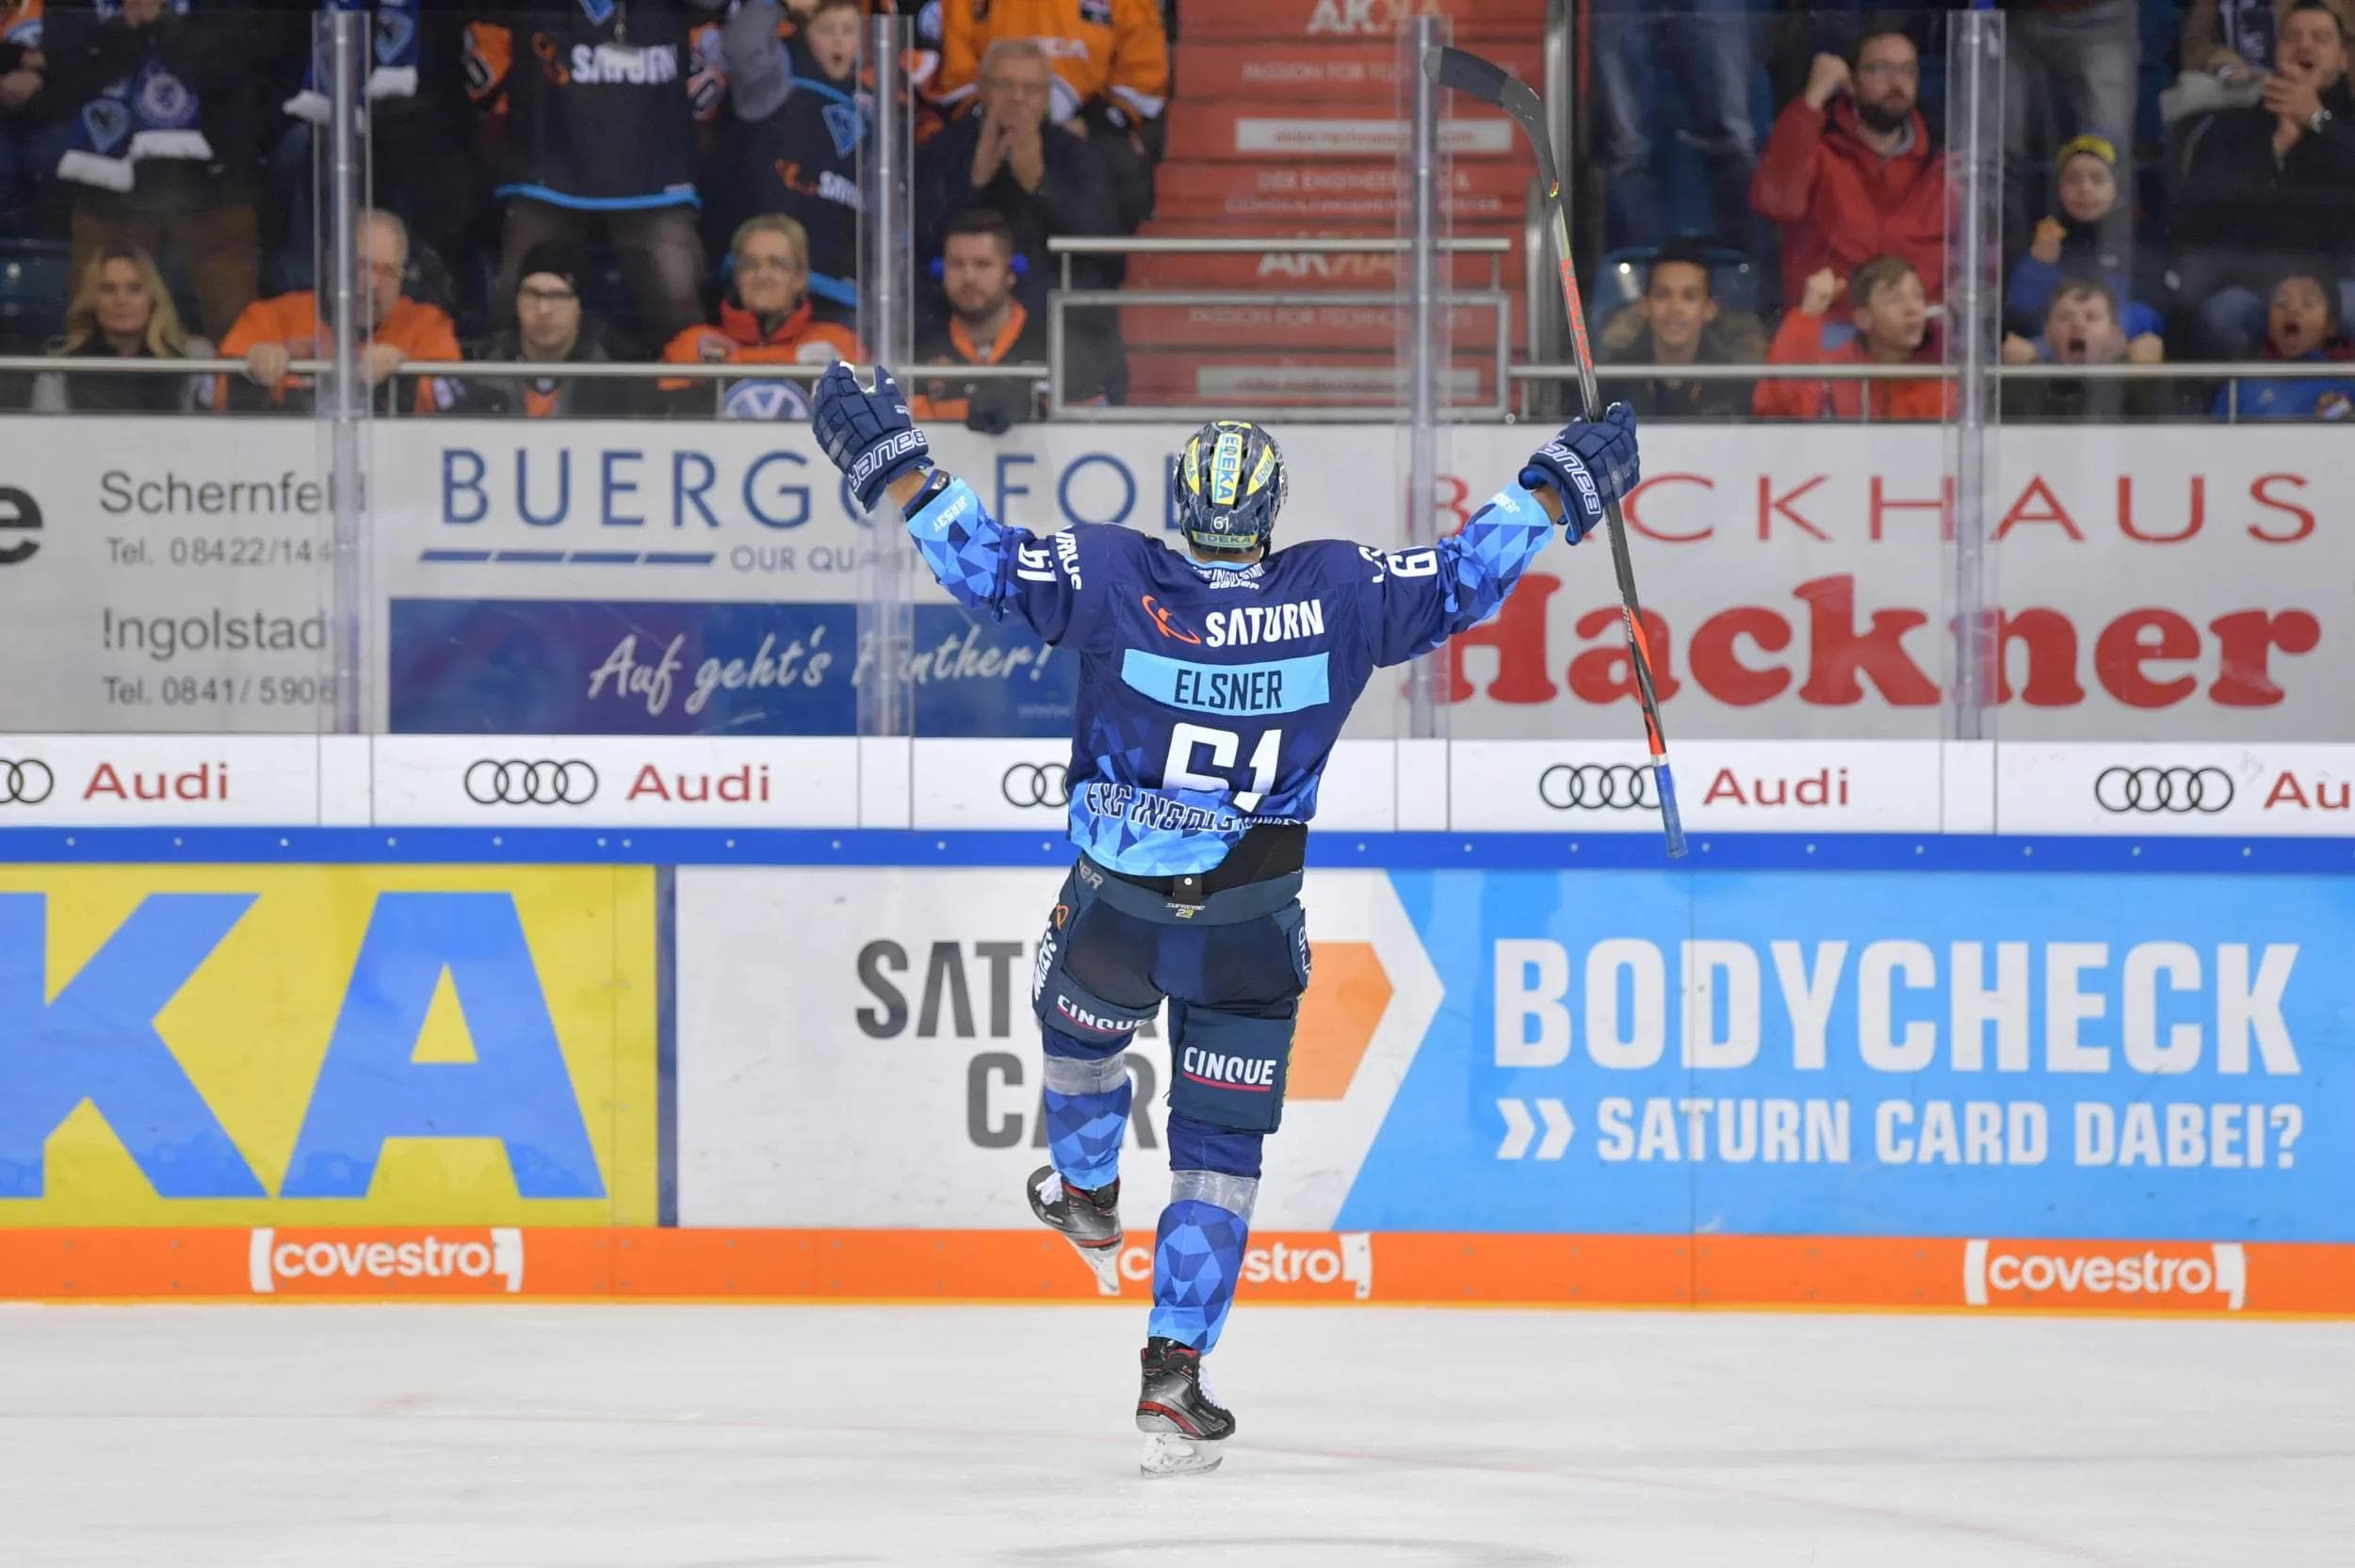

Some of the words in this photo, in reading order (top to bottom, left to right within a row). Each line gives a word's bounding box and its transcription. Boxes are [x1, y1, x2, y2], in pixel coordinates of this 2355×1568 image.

[1218, 436, 1238, 499] EDEKA
[1537, 442, 1601, 515] BAUE
[1196, 535, 1251, 543] EDEKA
[1213, 516, 1229, 530] 61
[729, 545, 795, 572] OUR
[1206, 599, 1325, 648] SATURN
[1400, 573, 2321, 708] Hackner
[588, 634, 685, 716] Auf
[685, 625, 831, 714] geht's
[1174, 670, 1282, 710] ELSNER
[83, 764, 230, 800] Audi
[626, 765, 771, 802] Audi
[1161, 722, 1282, 813] 61
[1702, 768, 1849, 805] Audi
[1494, 939, 2301, 1075] BODYCHECK
[0, 891, 608, 1199] KA
[1184, 1047, 1276, 1085] CINQUE
[1598, 1098, 1848, 1162] SATURN
[1876, 1100, 2048, 1165] CARD
[2074, 1103, 2303, 1169] DABEI?
[273, 1237, 492, 1277] covestro
[1119, 1242, 1341, 1283] cstro
[1989, 1251, 2212, 1293] covestro
